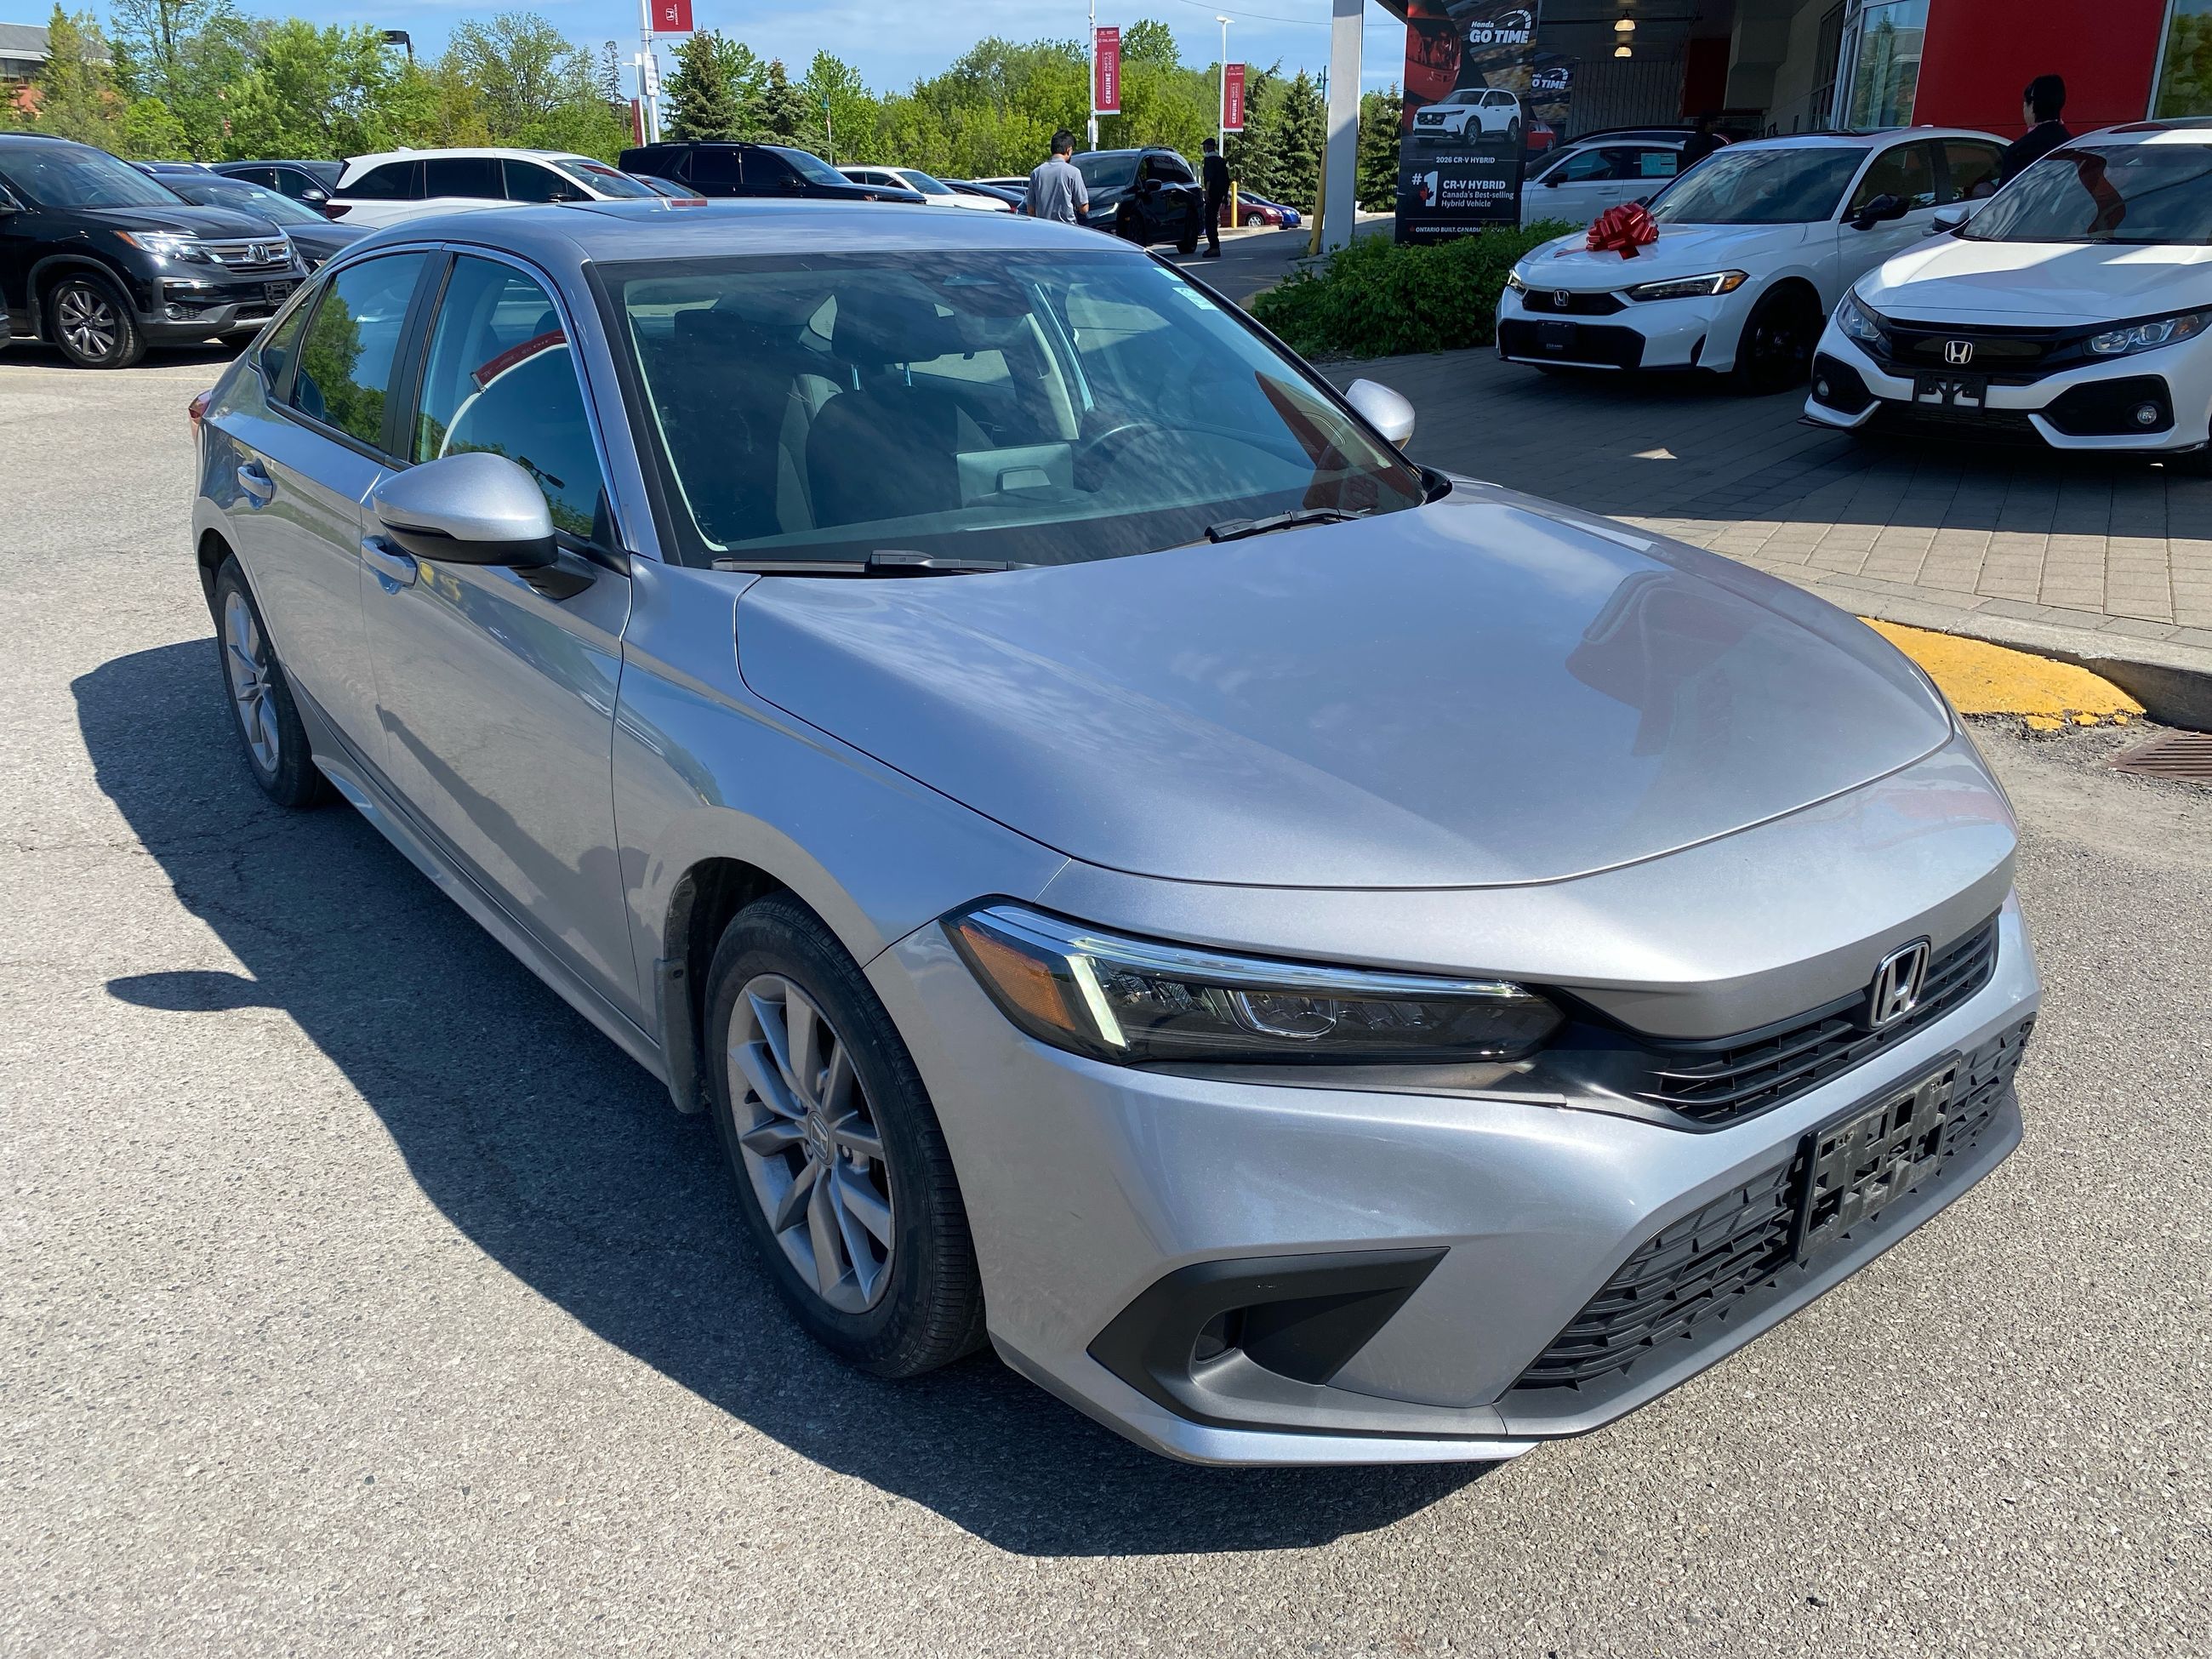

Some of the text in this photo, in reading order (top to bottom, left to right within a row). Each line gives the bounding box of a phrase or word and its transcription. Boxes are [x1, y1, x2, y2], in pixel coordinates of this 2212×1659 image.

[1469, 30, 1530, 43] GO TIME
[1532, 79, 1566, 89] O TIME
[1443, 180, 1506, 190] CR-V HYBRID
[1474, 191, 1514, 200] Best-selling
[1441, 200, 1465, 208] Hybrid
